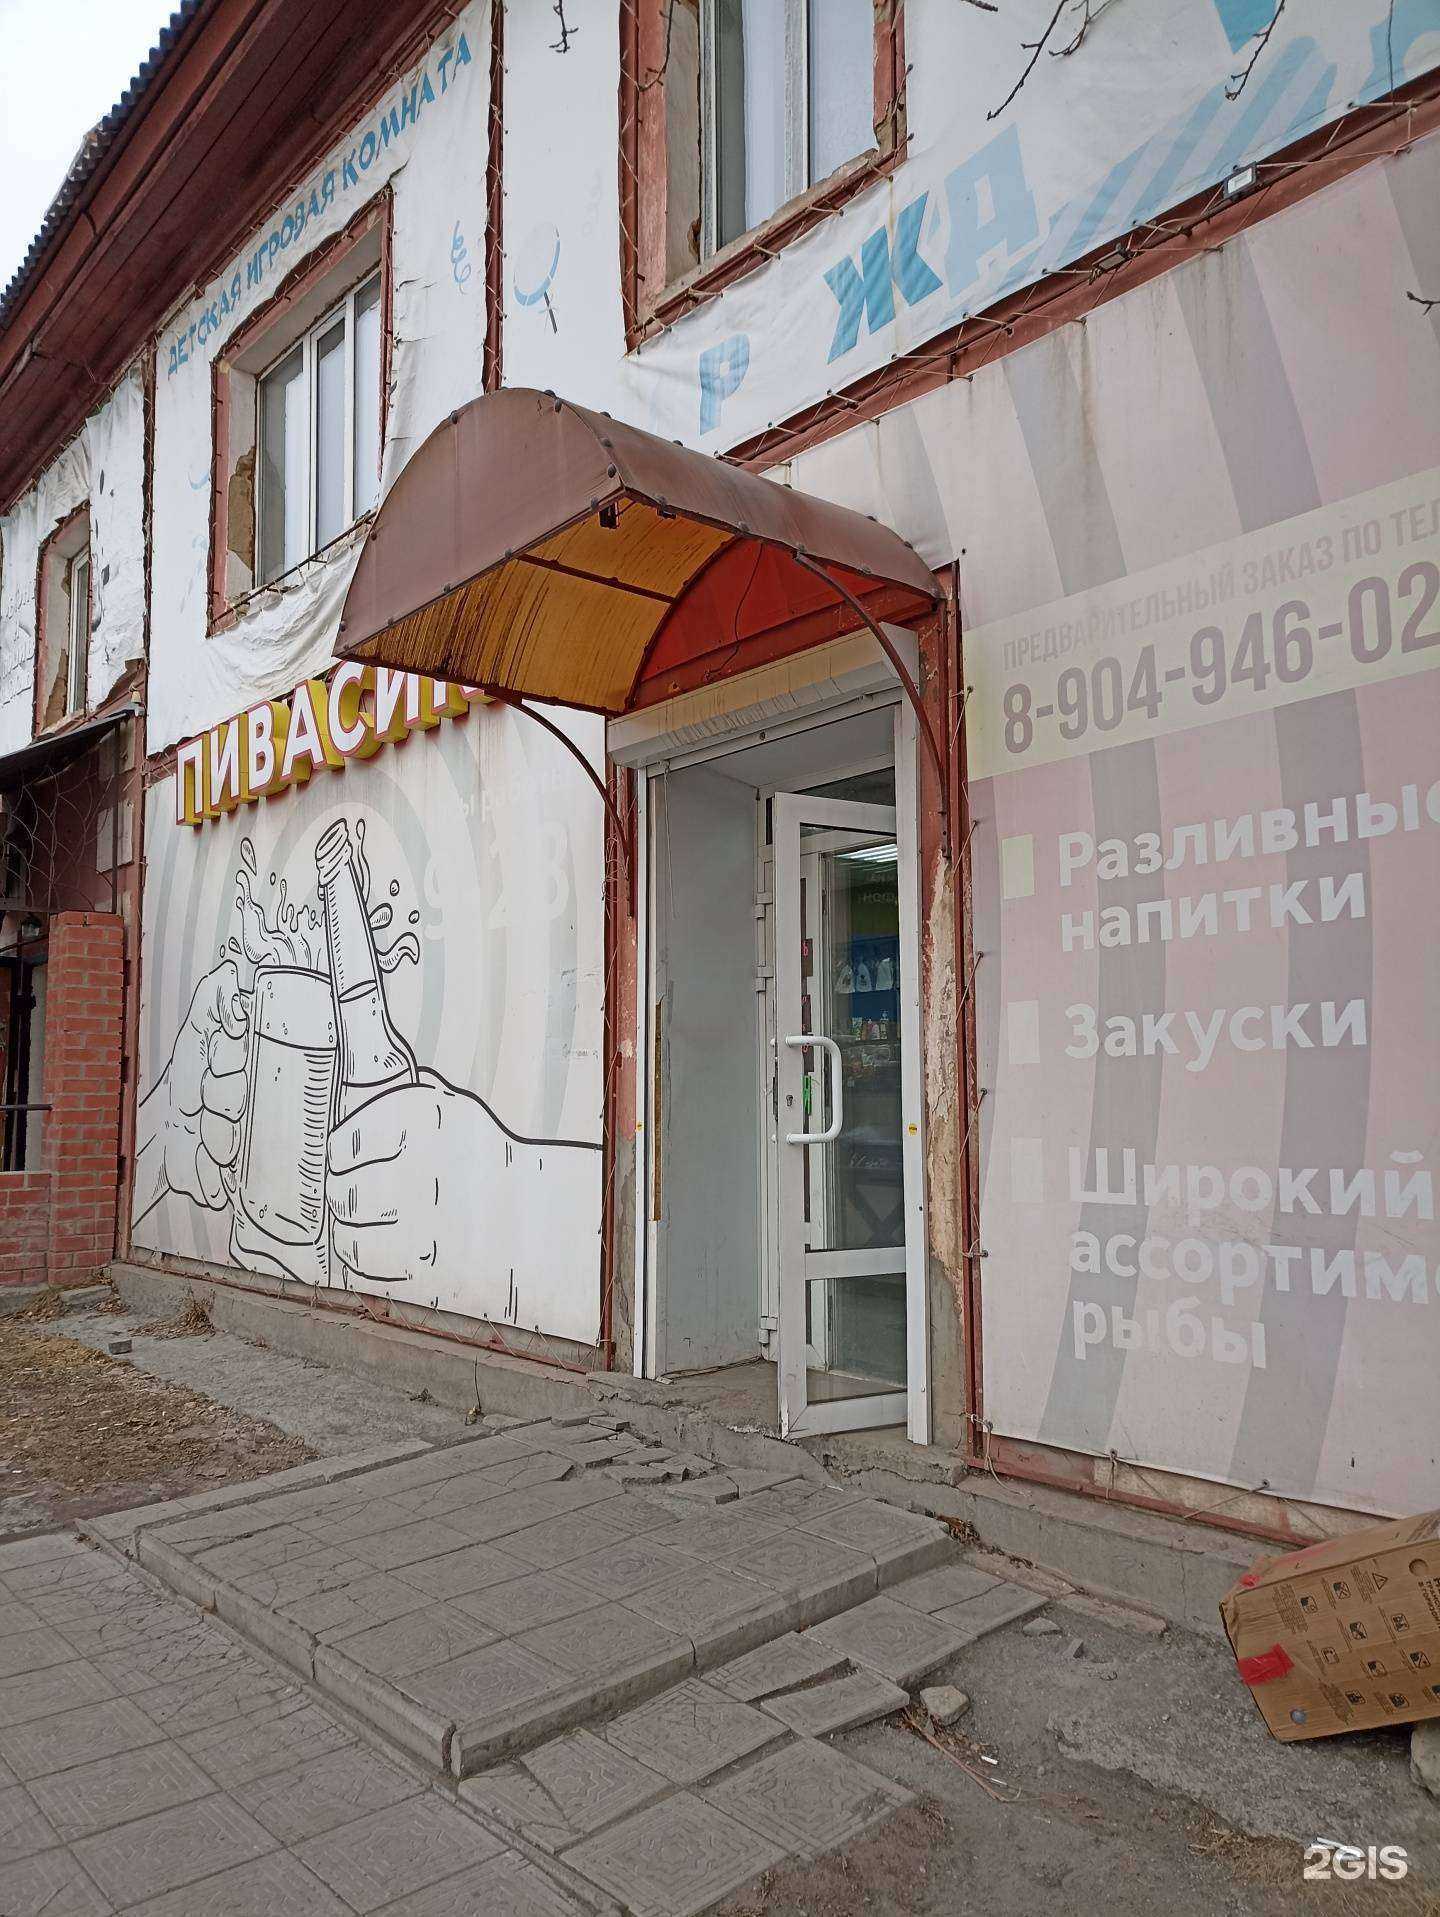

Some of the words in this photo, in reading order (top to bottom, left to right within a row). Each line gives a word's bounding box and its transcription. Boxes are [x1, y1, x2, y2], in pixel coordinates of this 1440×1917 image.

[167, 272, 242, 375] ДЕТСКАЯ
[246, 172, 335, 290] ИГРОВАЯ
[342, 32, 472, 191] КОМНАТА
[1002, 561, 1236, 672] ПРЕДВАРИТЕЛЬНЫЙ
[1242, 535, 1334, 595] ЗАКАЗ
[1342, 519, 1382, 563] ПО
[1002, 561, 1440, 754] 8-904-946-02
[175, 660, 486, 826] ПИВАСИ
[1058, 778, 1440, 887] Разливны
[1061, 872, 1367, 952] напитки
[1065, 998, 1368, 1073] Закуски
[1067, 1149, 1435, 1227] Широкий
[1069, 1229, 1440, 1306] ассортим
[1072, 1296, 1267, 1369] рыбы
